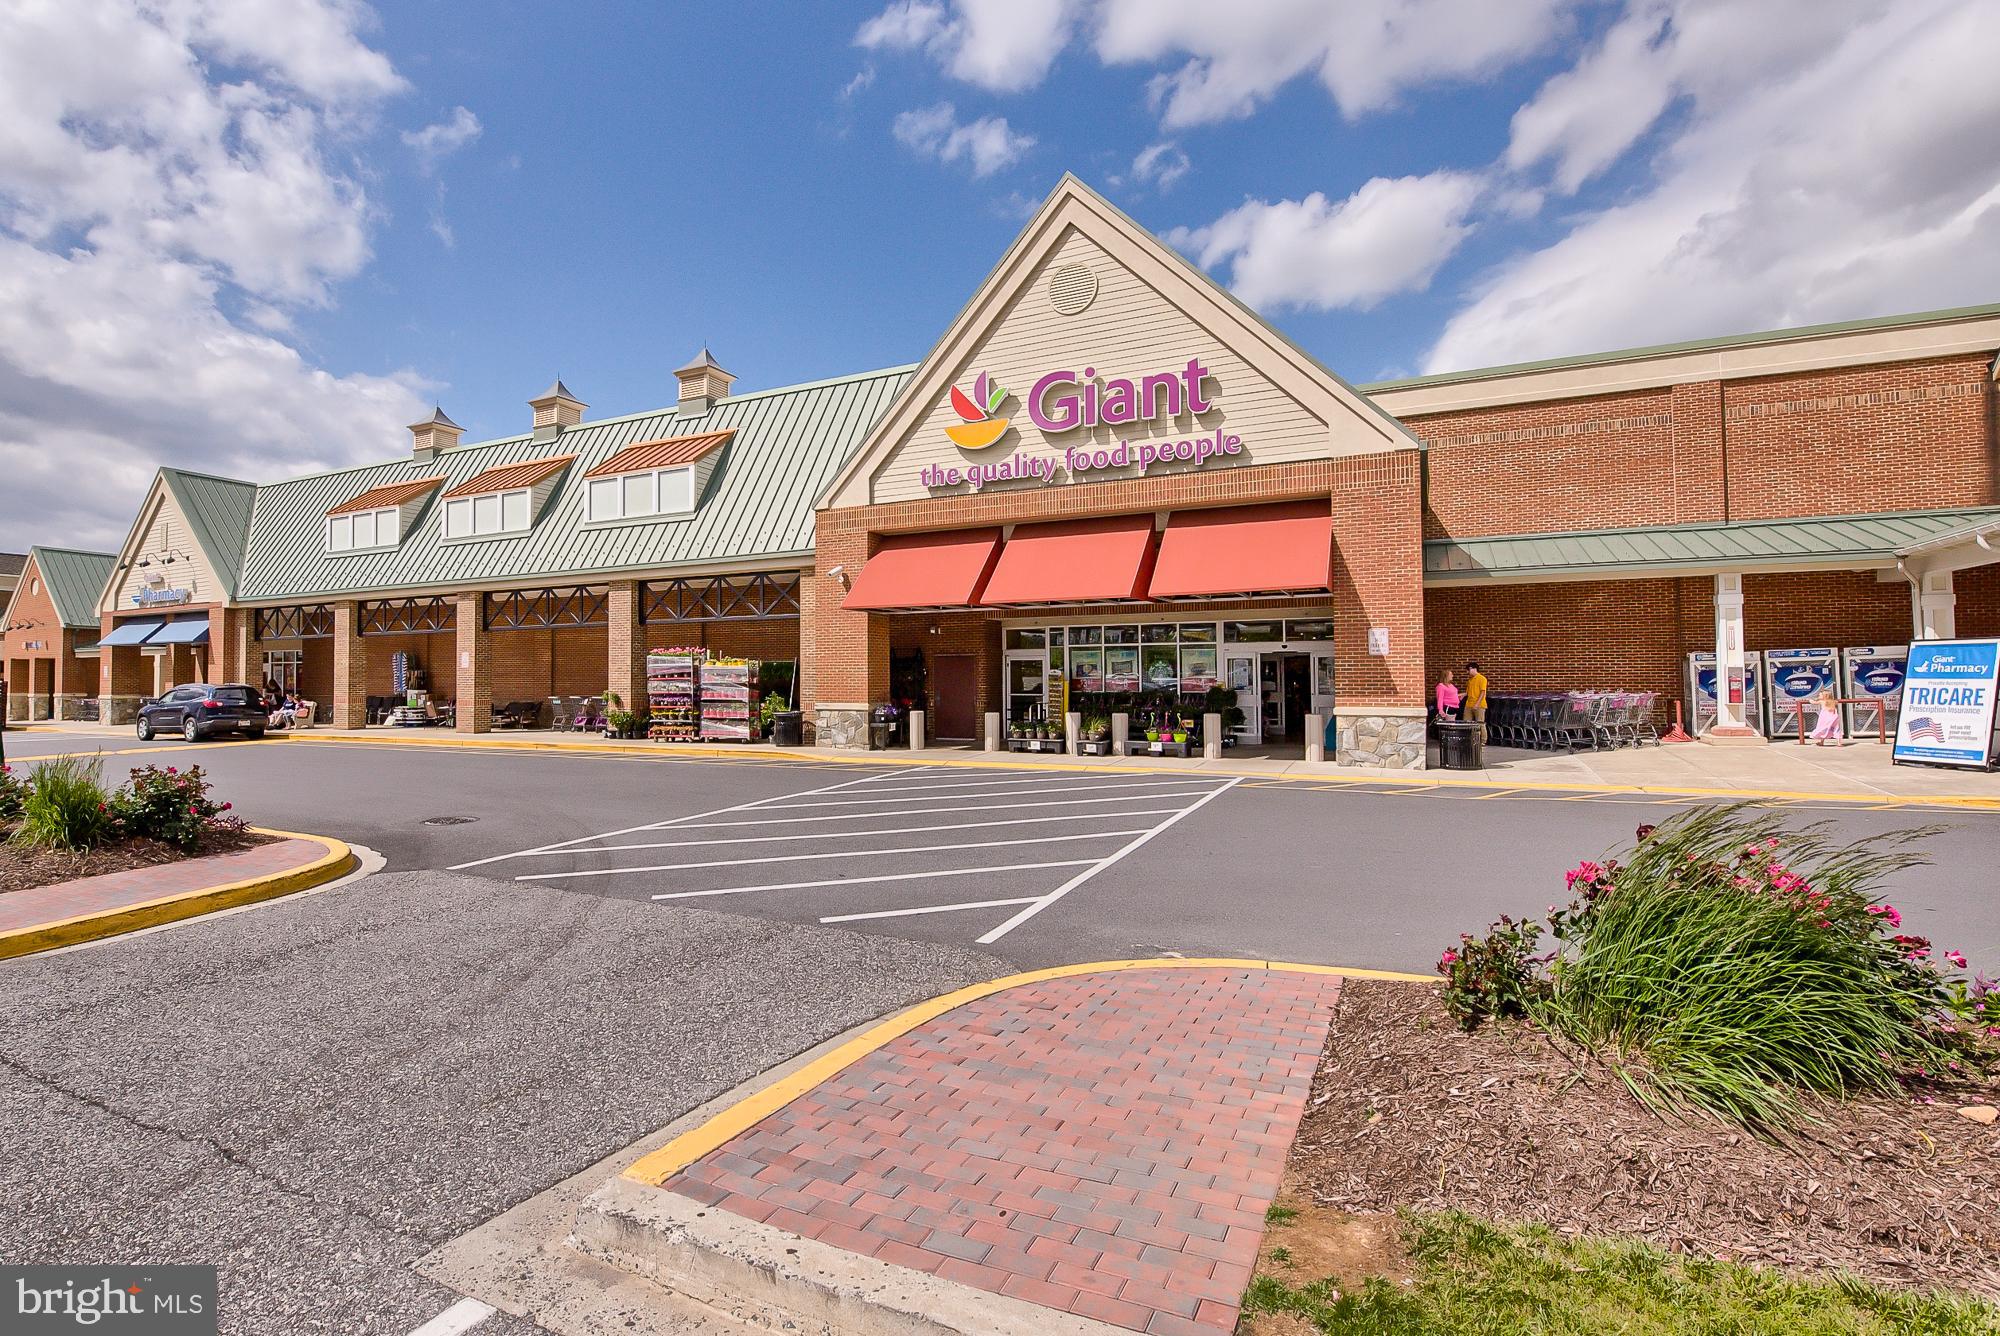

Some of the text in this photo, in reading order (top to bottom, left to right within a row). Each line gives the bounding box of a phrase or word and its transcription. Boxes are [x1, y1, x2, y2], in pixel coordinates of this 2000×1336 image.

[1028, 357, 1213, 433] Giant
[920, 428, 1241, 489] the quality food people
[143, 588, 187, 604] Pharmacy
[1932, 655, 1955, 663] Giant
[1930, 663, 1988, 675] Pharmacy
[1909, 687, 1985, 706] TRICARE
[1909, 705, 1981, 715] Prescription Insurance
